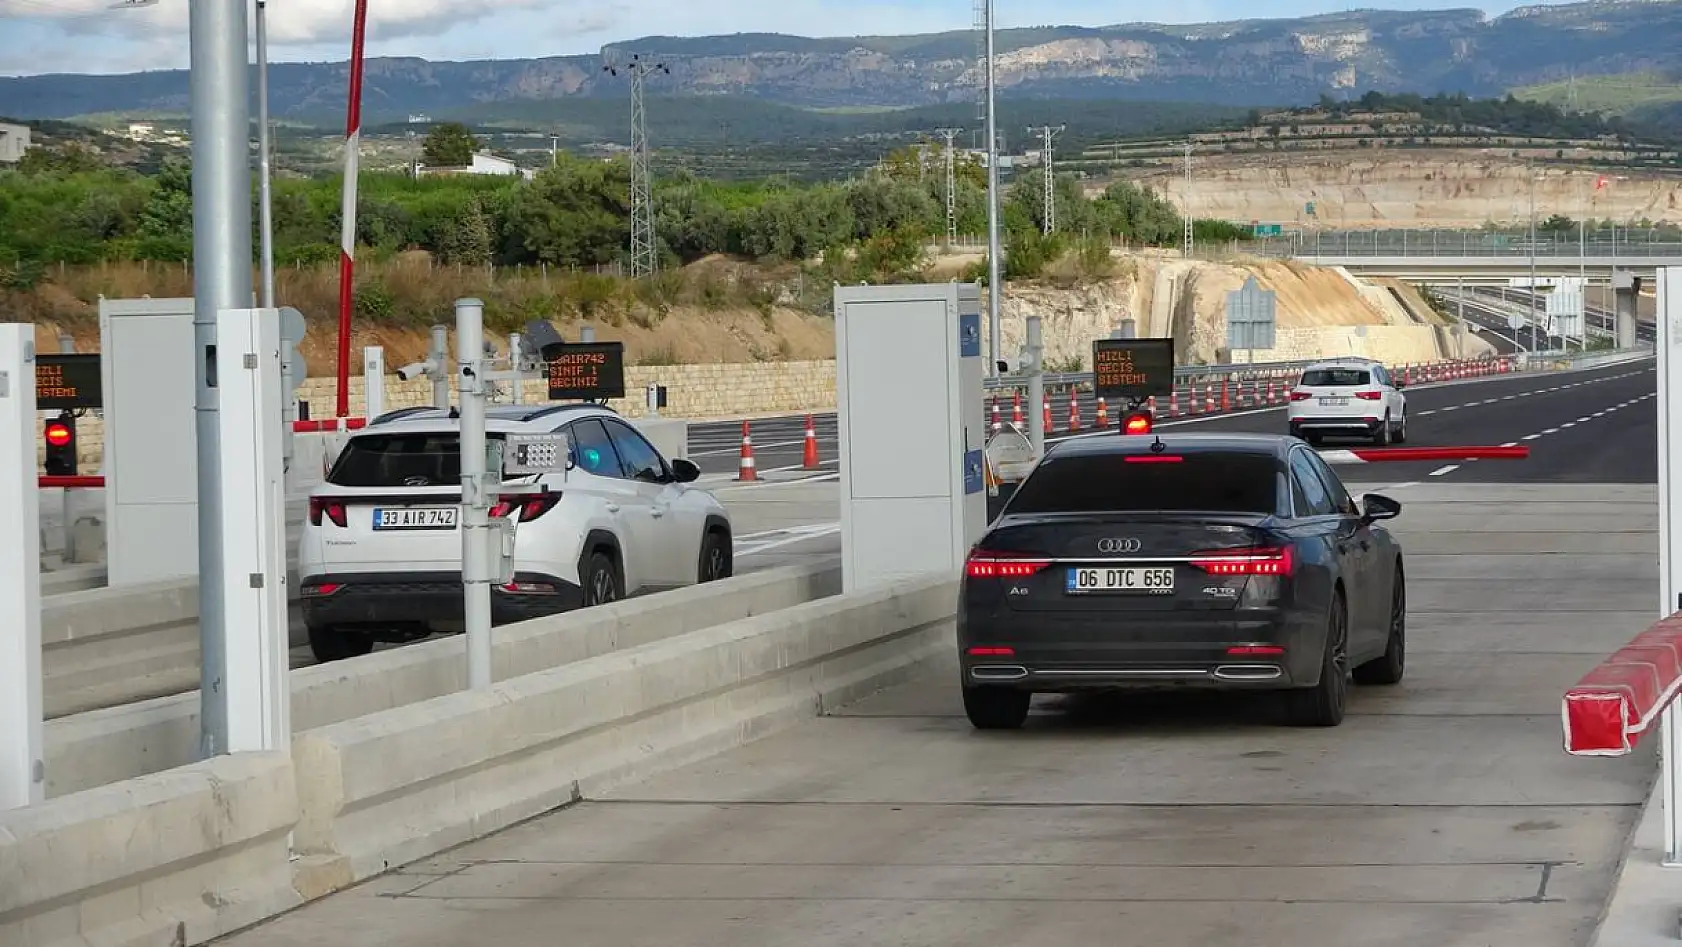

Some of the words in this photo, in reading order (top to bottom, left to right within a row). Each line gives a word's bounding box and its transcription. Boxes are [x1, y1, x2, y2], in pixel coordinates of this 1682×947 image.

[550, 352, 606, 364] AIR742
[1097, 350, 1132, 361] HIZLI
[36, 365, 63, 375] IZLI
[550, 365, 584, 376] SINIF
[591, 366, 598, 375] 1
[1097, 362, 1133, 373] GECIS
[36, 376, 64, 386] ECIS
[550, 376, 598, 387] GECINIZ
[1099, 373, 1148, 385] SISTEMI
[36, 387, 77, 397] ISTEMI
[383, 511, 398, 525] 33
[403, 511, 426, 525] AIR
[429, 510, 453, 524] 742
[1079, 569, 1098, 587] 06
[1107, 569, 1135, 587] DTC
[1144, 569, 1172, 587] 656
[1010, 586, 1029, 596] A6
